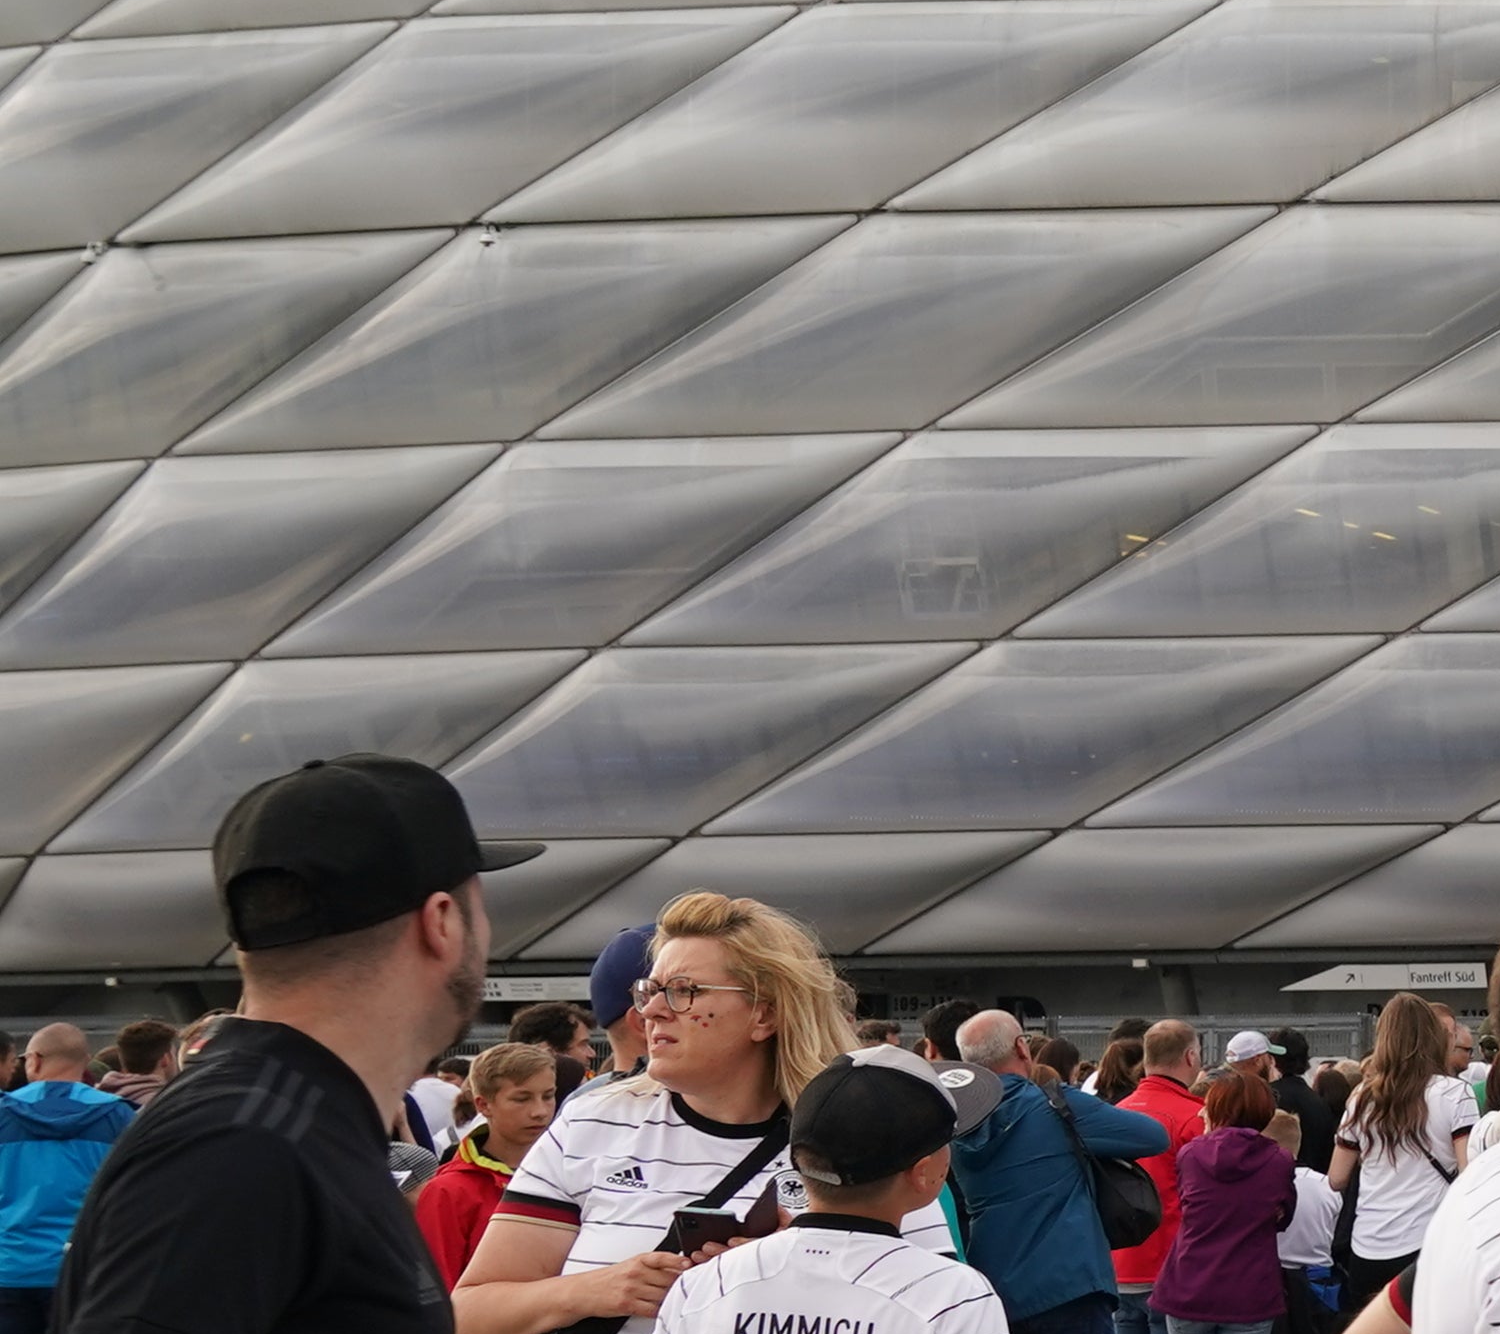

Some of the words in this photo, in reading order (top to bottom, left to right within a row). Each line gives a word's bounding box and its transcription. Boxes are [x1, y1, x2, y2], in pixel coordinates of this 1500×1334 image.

[1410, 971, 1452, 984] Fantreff
[1455, 971, 1475, 983] Süd
[606, 1175, 649, 1190] adidas
